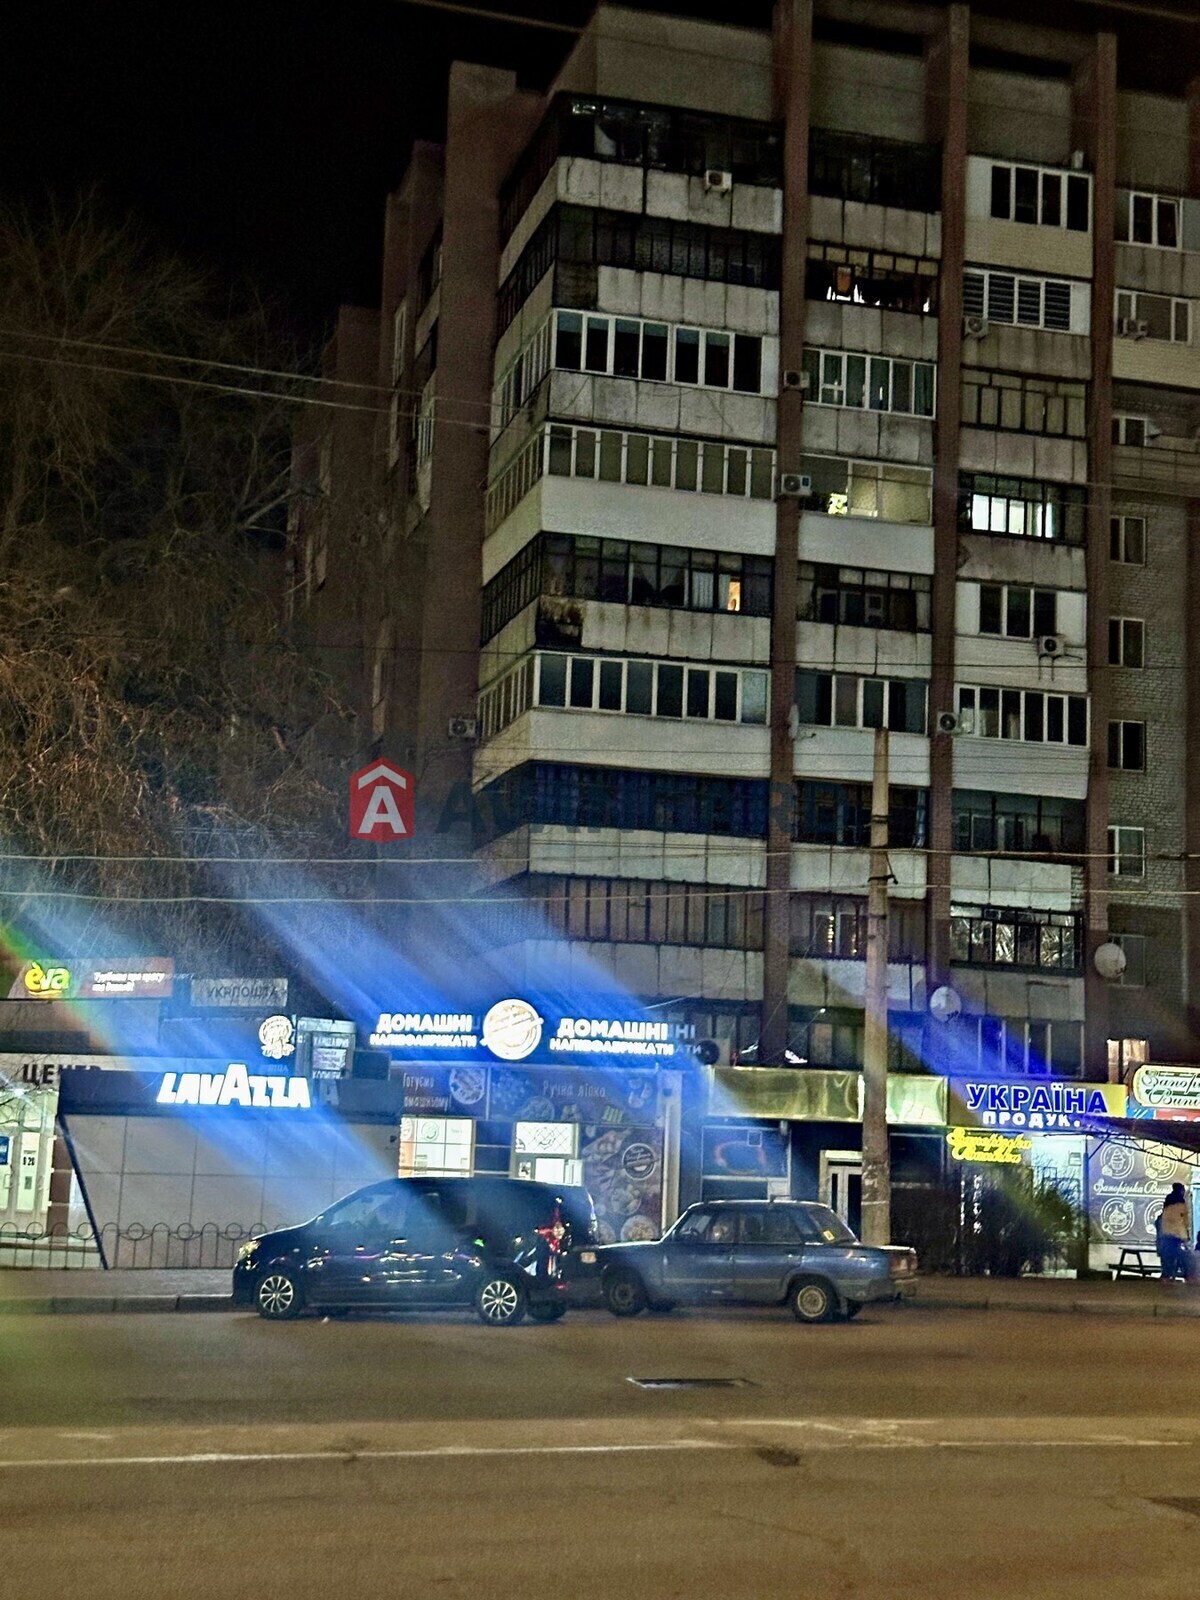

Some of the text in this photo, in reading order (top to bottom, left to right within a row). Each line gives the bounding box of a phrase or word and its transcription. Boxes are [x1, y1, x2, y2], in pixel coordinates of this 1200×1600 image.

[207, 984, 278, 1000] УКРПОШТА
[377, 1014, 473, 1033] ДОМАШНІ
[557, 1019, 669, 1041] ДОМАШНІ
[157, 1063, 311, 1108] LAVAZZA
[966, 1083, 1109, 1114] УКРАЇНА
[982, 1111, 1081, 1129] ПРОДУК.
